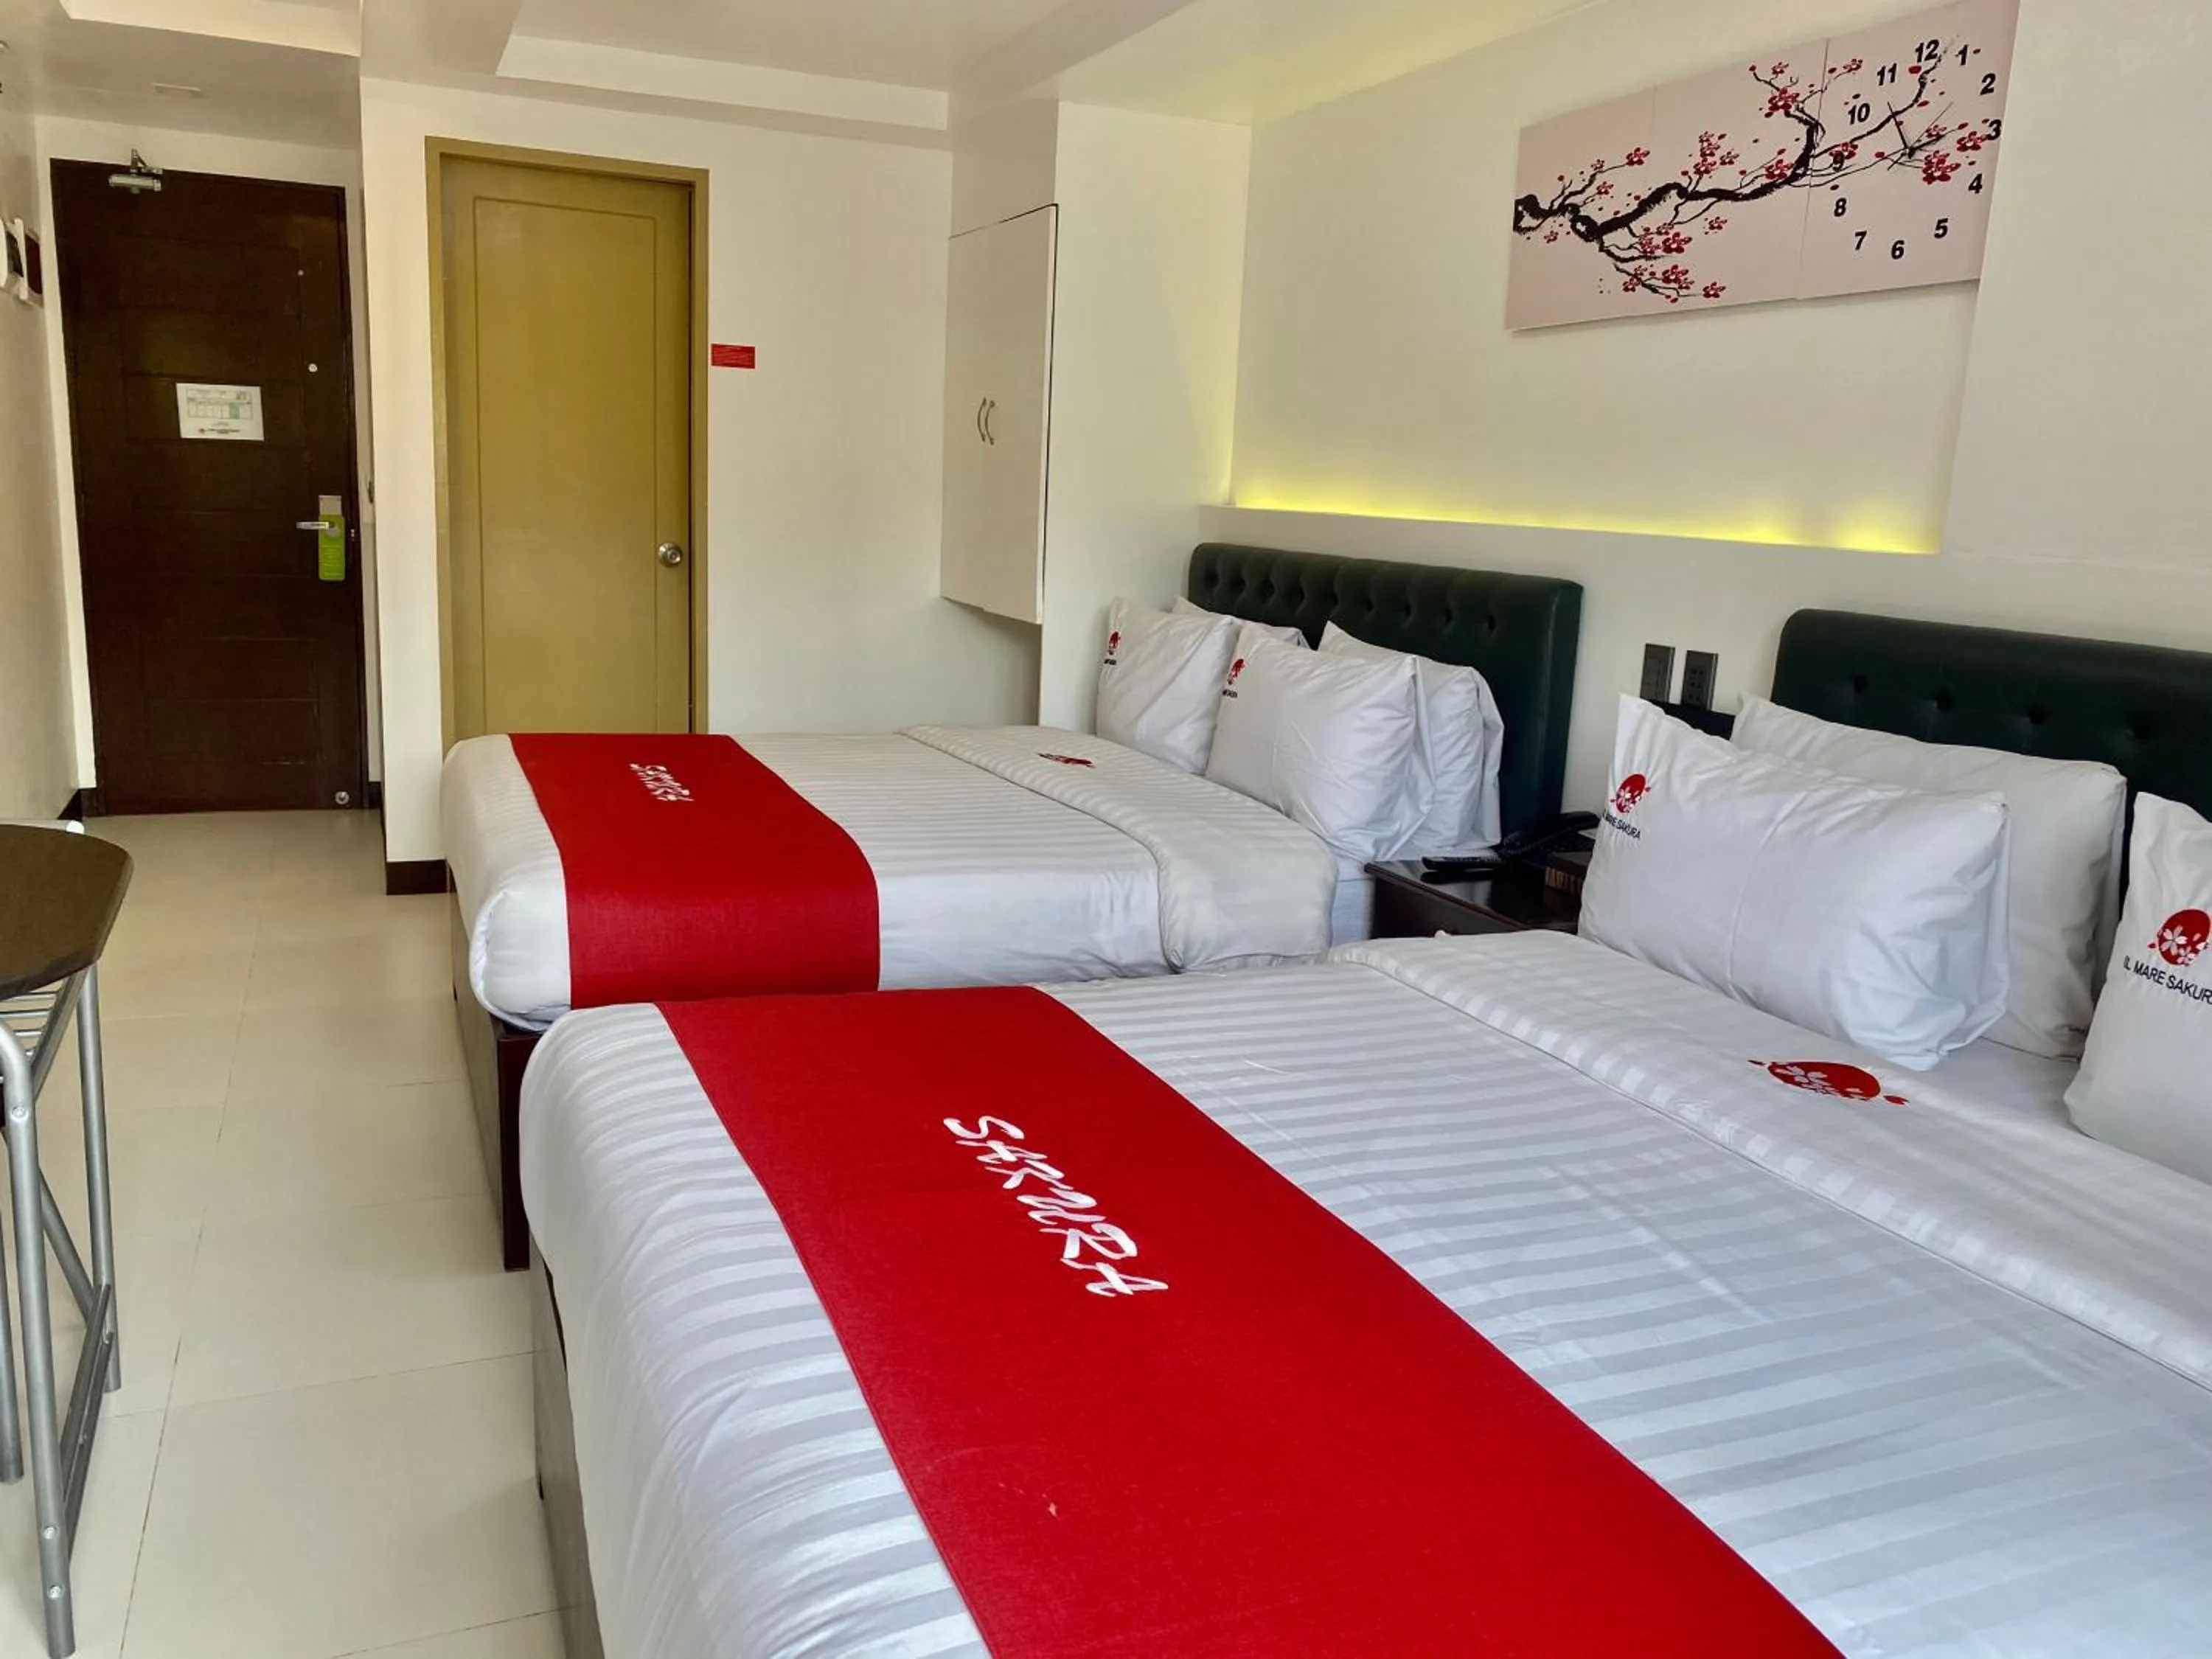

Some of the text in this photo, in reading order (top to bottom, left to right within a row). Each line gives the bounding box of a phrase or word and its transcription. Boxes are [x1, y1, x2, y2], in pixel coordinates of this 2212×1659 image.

[1915, 39, 1939, 62] 12
[1957, 44, 1969, 65] 1
[1877, 63, 1897, 86] 11
[1980, 73, 1996, 95] 2
[1847, 102, 1871, 125] 10
[1987, 119, 2001, 140] 3
[1968, 173, 1983, 194] 4
[1834, 198, 1847, 217] 8
[1934, 218, 1948, 238] 5
[1854, 231, 1867, 250] 7
[1891, 240, 1905, 259] 6
[2134, 960, 2166, 985] MARE
[2166, 974, 2212, 1005] SAKUR
[943, 1116, 1169, 1297] SAKURA
